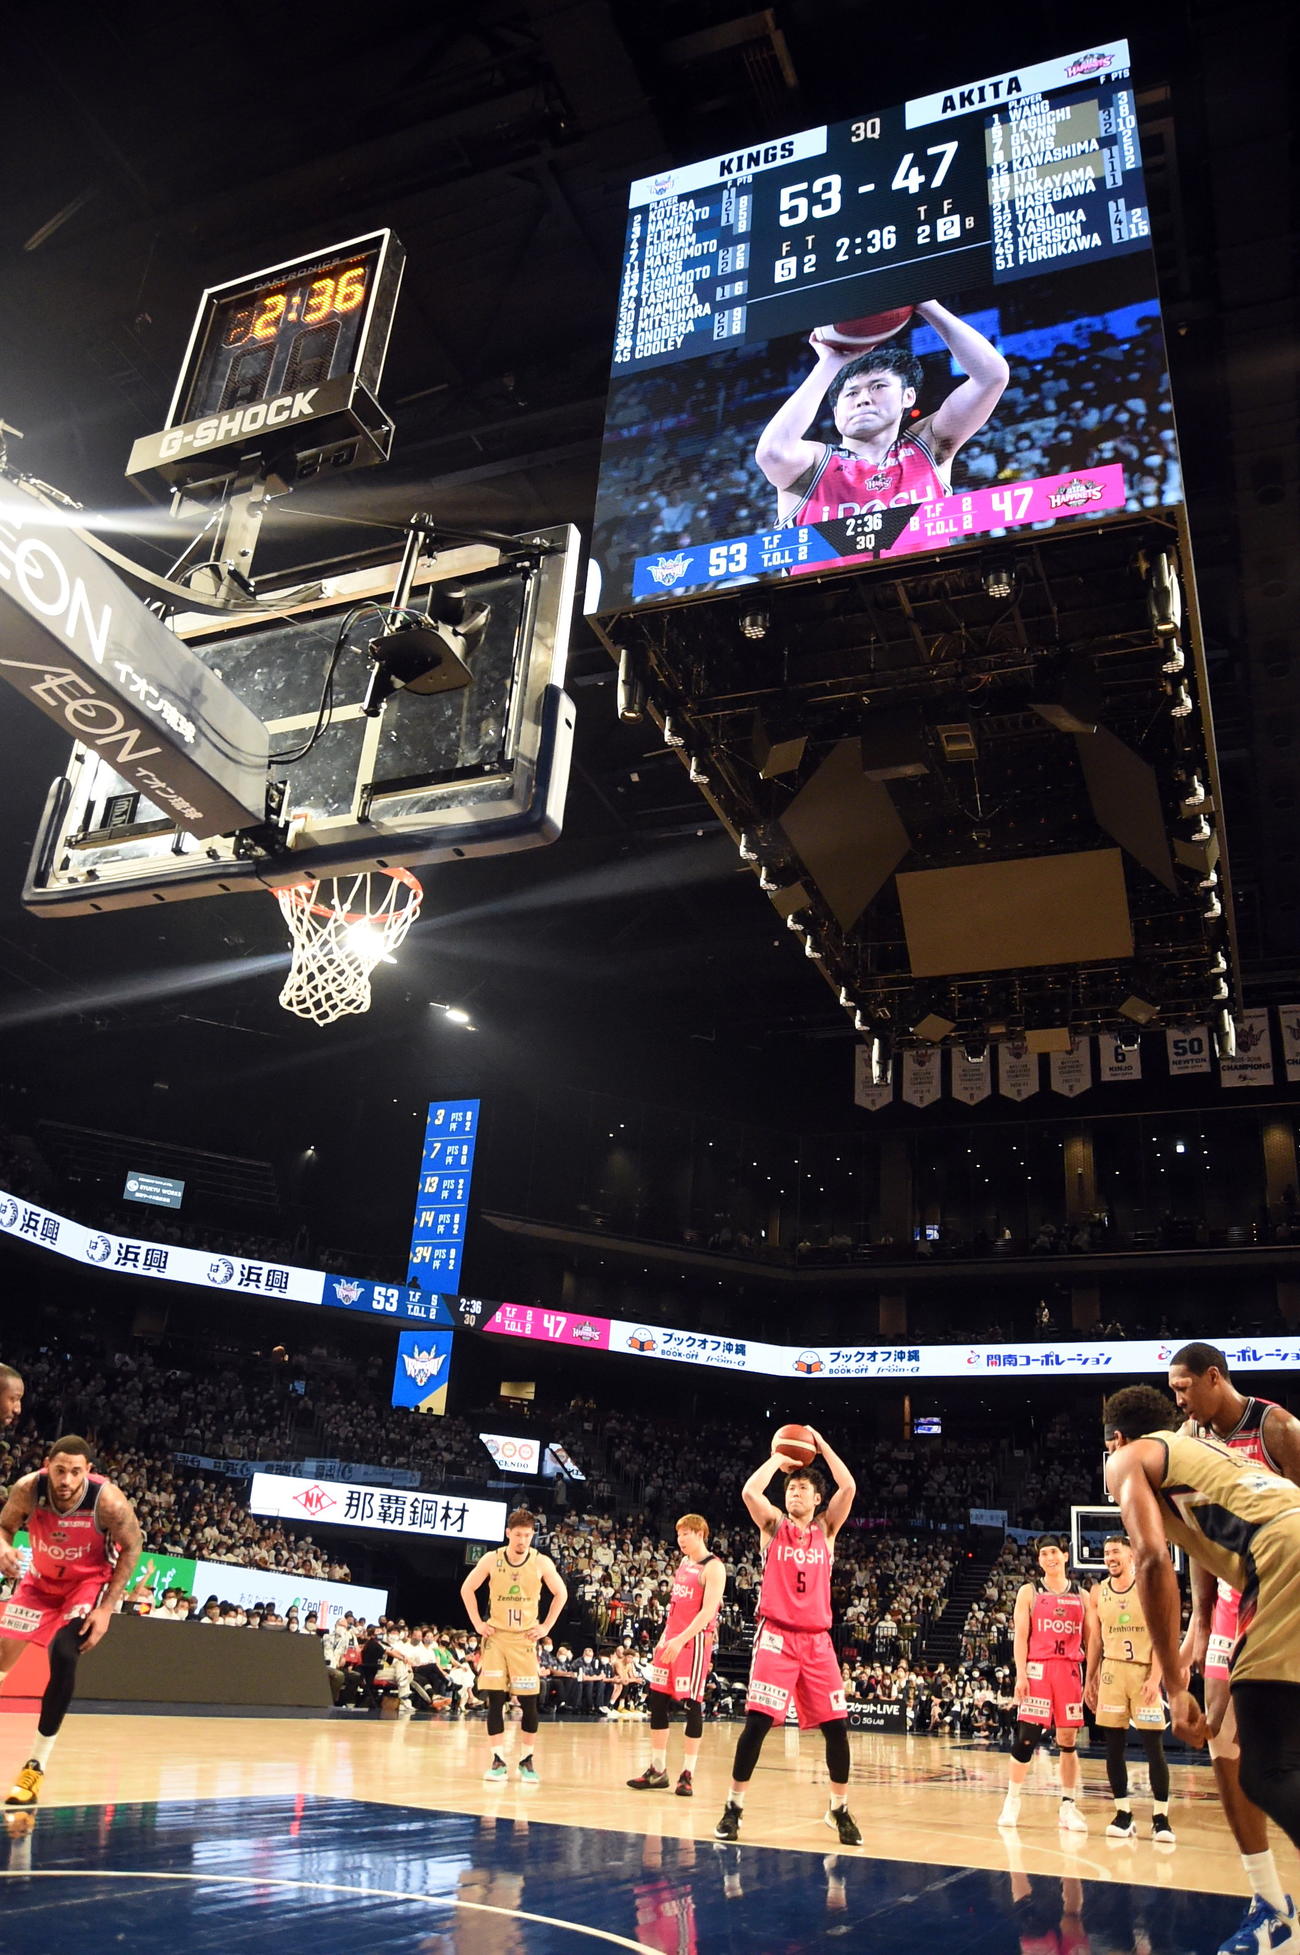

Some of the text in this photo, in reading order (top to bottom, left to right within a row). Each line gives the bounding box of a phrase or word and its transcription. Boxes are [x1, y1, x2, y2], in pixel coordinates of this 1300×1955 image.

[1100, 69, 1130, 84] F PTS
[940, 76, 1022, 114] AKITA
[1009, 93, 1042, 109] PLAYER
[992, 100, 1050, 125] 1 WANG
[1010, 107, 1071, 133] TAGUCHI
[851, 118, 880, 142] 3Q
[1011, 124, 1056, 146] GLYNN
[1011, 115, 1135, 159] DAVIS 10
[718, 140, 794, 177] KINGS
[992, 138, 1100, 176] 12 KAWASHIMA
[737, 175, 752, 186] PTS
[779, 141, 959, 227] 53 47
[992, 166, 1095, 203] 17 NAKAYAMA
[1013, 169, 1036, 183] ITO
[650, 196, 678, 209] PLAYER
[917, 199, 952, 221] T F
[993, 180, 1096, 216] 21 HASEGAWA
[634, 200, 696, 227] 2 KOTERA
[648, 207, 709, 233] NAMIZATO
[994, 204, 1054, 228] 22 TADA
[994, 208, 1086, 243] 24 YASUOKA
[630, 223, 693, 249] 4 FLIPPIN
[917, 216, 974, 244] 2 B
[995, 208, 1142, 255] 45 IVERSON 2
[630, 233, 696, 262] 7 DURHAM
[782, 235, 815, 256] F T
[835, 225, 896, 262] 2:36
[996, 222, 1148, 270] 51 FURUKAWA 15
[626, 239, 717, 275] 11 MATSUMOTO
[804, 254, 816, 274] 2
[641, 266, 710, 294] KISHIMOTO
[642, 261, 683, 282] EVANS
[254, 267, 365, 338] 2:36
[621, 282, 694, 311] 24 TASHIRO
[639, 293, 698, 320] IMAMURA
[638, 303, 711, 333] MITSUHARA
[637, 320, 694, 345] ONODERA
[614, 335, 684, 363] 45 COOLEY
[159, 388, 320, 458] G-SHOCK
[992, 487, 1033, 521] 47
[846, 513, 882, 536] 2:36
[856, 534, 875, 550] 3Q
[709, 542, 747, 576] 53
[1173, 1037, 1203, 1056] 50
[1222, 1063, 1271, 1071] CHAMPIONS
[435, 1109, 463, 1125] 3 PTS
[464, 1122, 471, 1131] 2
[430, 1143, 459, 1159] 7 PTS
[424, 1177, 439, 1193] 13
[443, 1180, 455, 1188] PTS
[420, 1211, 450, 1227] 14 PTS
[413, 1246, 446, 1263] 34 PTS
[372, 1286, 399, 1312] 53
[459, 1298, 482, 1314] 2:36
[464, 1314, 476, 1326] 3Q
[543, 1314, 567, 1338] 47
[662, 1332, 746, 1357] ブックオフ沖縄
[829, 1350, 919, 1363] ブックオフ沖縄
[304, 1491, 324, 1510] NK
[344, 1490, 470, 1532] 那覇鋼材
[38, 1538, 92, 1560] POSH
[784, 1546, 824, 1564] POSH
[55, 1566, 65, 1578] 7
[797, 1572, 806, 1593] 5
[508, 1609, 521, 1627] 14
[1044, 1620, 1082, 1634] POSH
[1055, 1640, 1065, 1655] 16
[1124, 1641, 1133, 1660] 3
[846, 1702, 900, 1716] スケットLIVE
